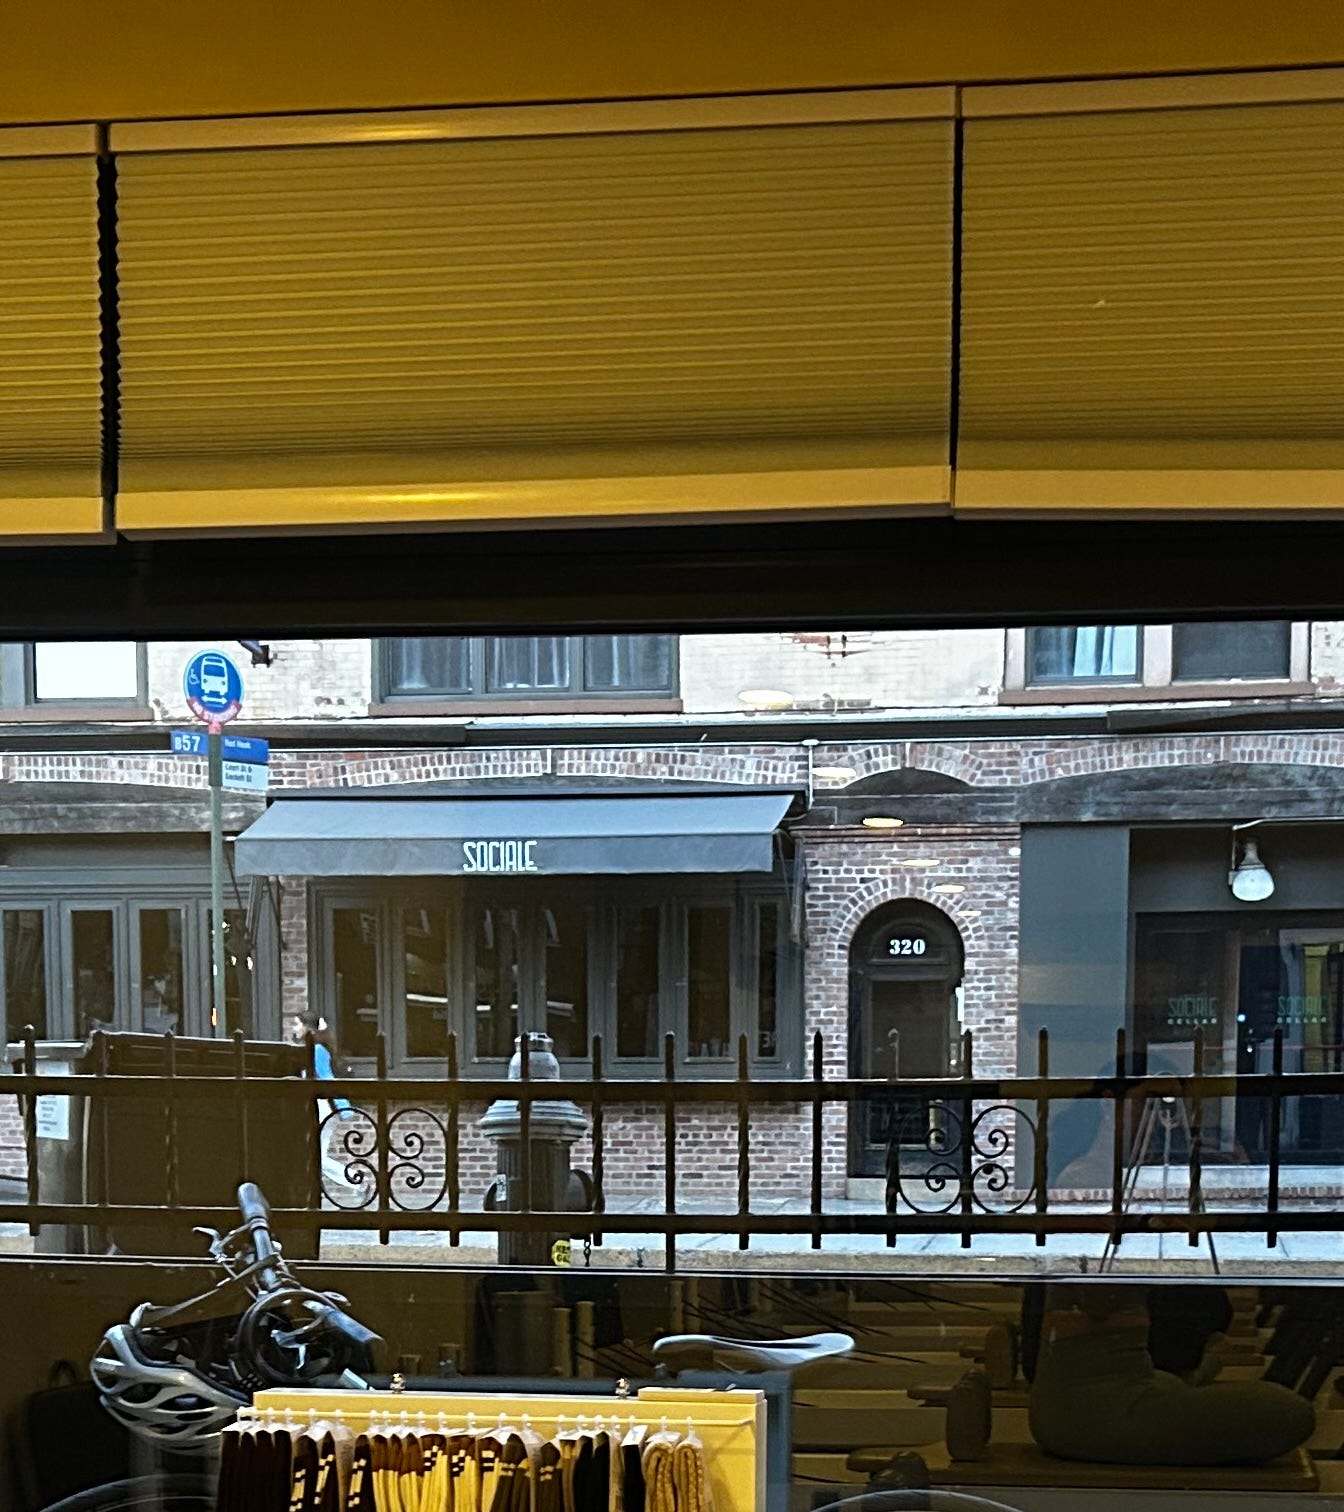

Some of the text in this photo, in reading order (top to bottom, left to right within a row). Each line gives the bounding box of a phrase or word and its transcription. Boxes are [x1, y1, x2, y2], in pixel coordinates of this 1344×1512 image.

[174, 734, 200, 752] B57
[462, 840, 538, 872] SOCIALE
[889, 938, 926, 955] 320
